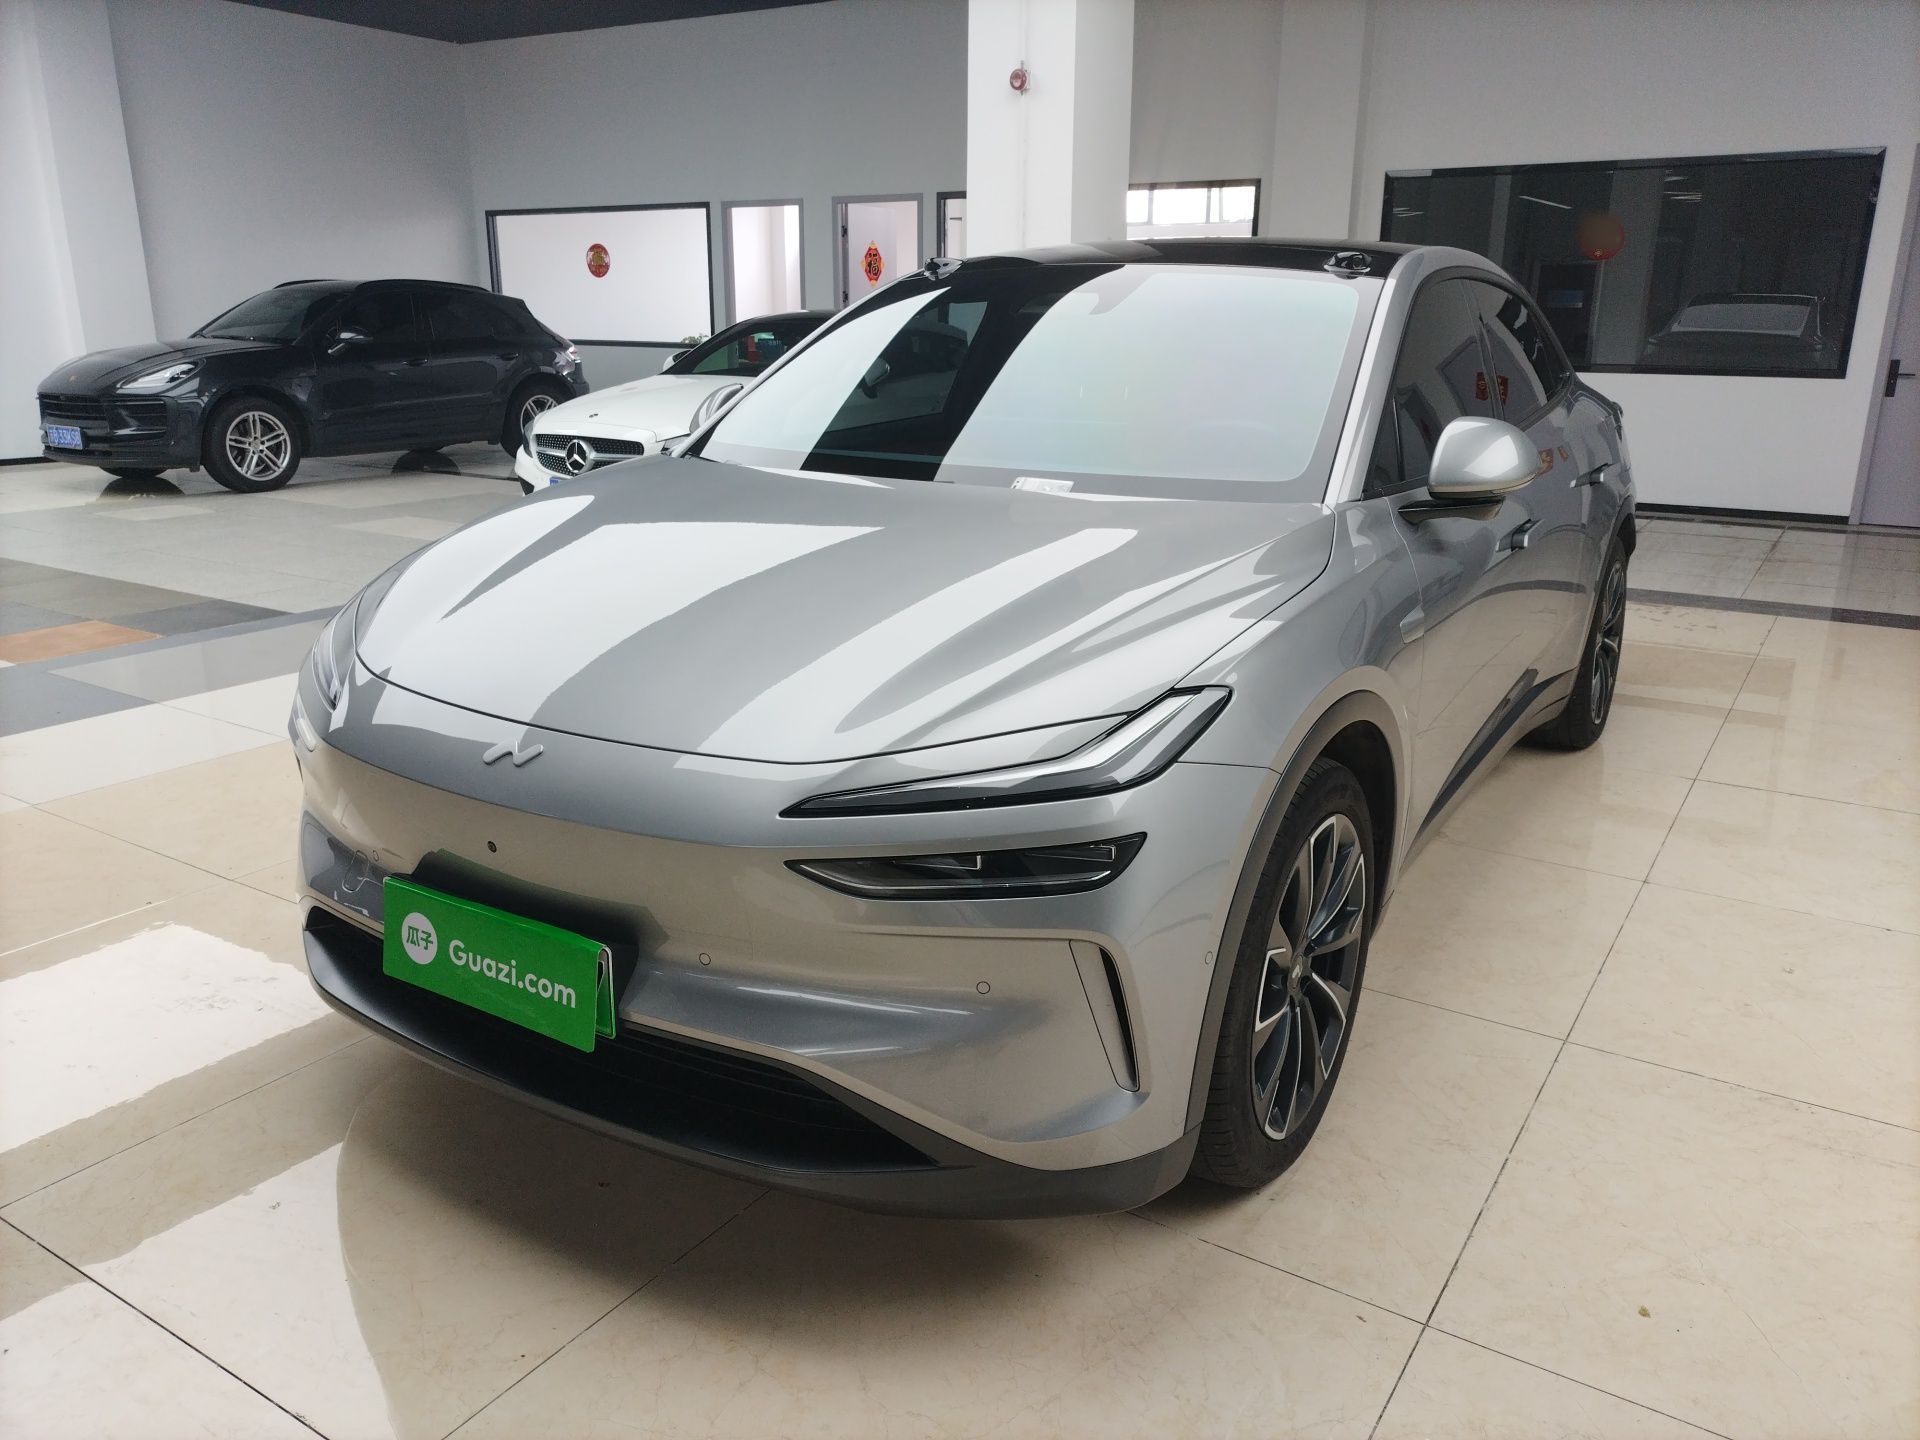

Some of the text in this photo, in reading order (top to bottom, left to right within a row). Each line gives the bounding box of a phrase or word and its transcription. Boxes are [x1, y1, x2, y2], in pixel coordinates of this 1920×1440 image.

[867, 252, 880, 276] 福
[406, 924, 434, 951] 瓜子
[448, 939, 577, 1009] Guazi.com
